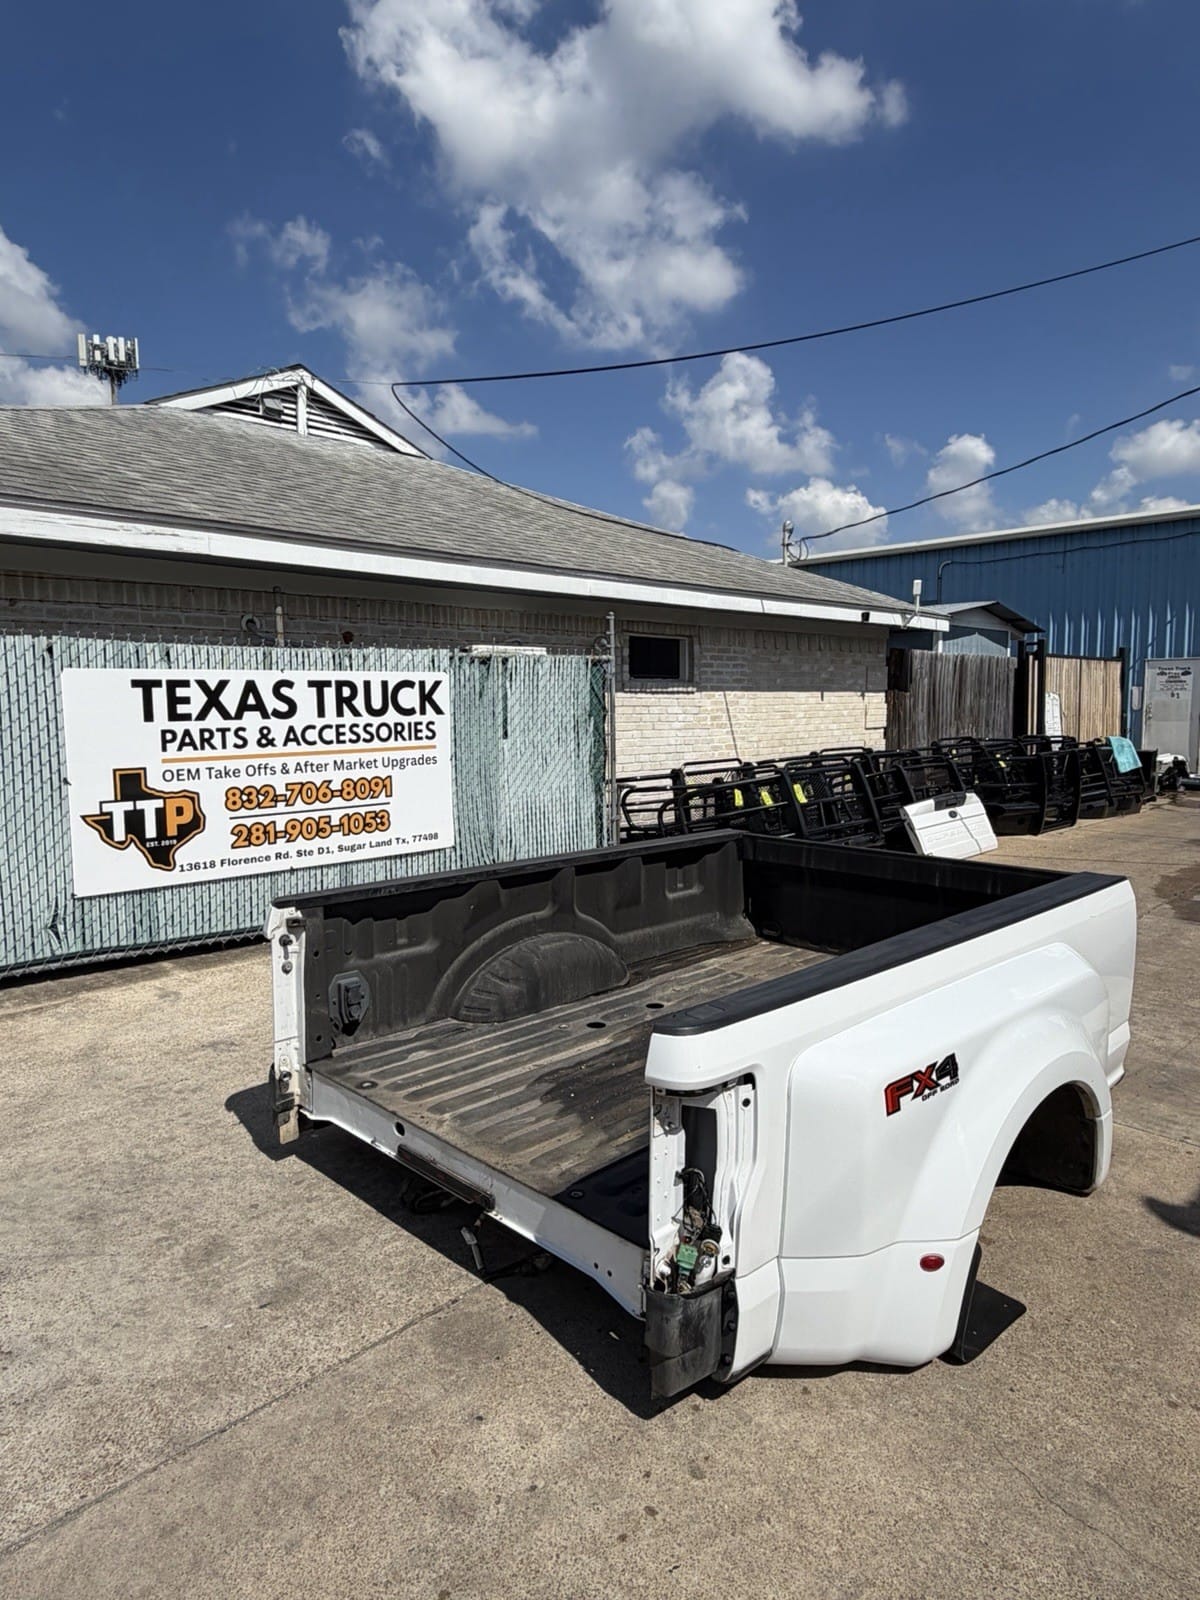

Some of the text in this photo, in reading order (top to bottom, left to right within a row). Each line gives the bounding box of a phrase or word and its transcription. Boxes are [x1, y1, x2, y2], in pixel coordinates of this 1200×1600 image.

[131, 678, 445, 722] TEXAS TRUCK
[160, 721, 436, 752] PARTS & ACCESSORIES
[162, 754, 438, 782] OEM Take Offs & After Market Upgrades
[224, 775, 393, 812] 832-706-8091
[101, 797, 195, 842] TTP
[230, 809, 391, 849] 281-905-1053
[178, 860, 217, 873] 13618
[220, 854, 272, 868] Florence
[275, 850, 293, 861] Rd.
[296, 849, 314, 858] Ste
[317, 846, 335, 856] D1,
[337, 843, 366, 853] Sugar
[369, 838, 393, 849] Land
[395, 837, 410, 845] Tx,
[884, 1052, 959, 1117] FX4
[921, 1078, 960, 1102] OFF ROAD
